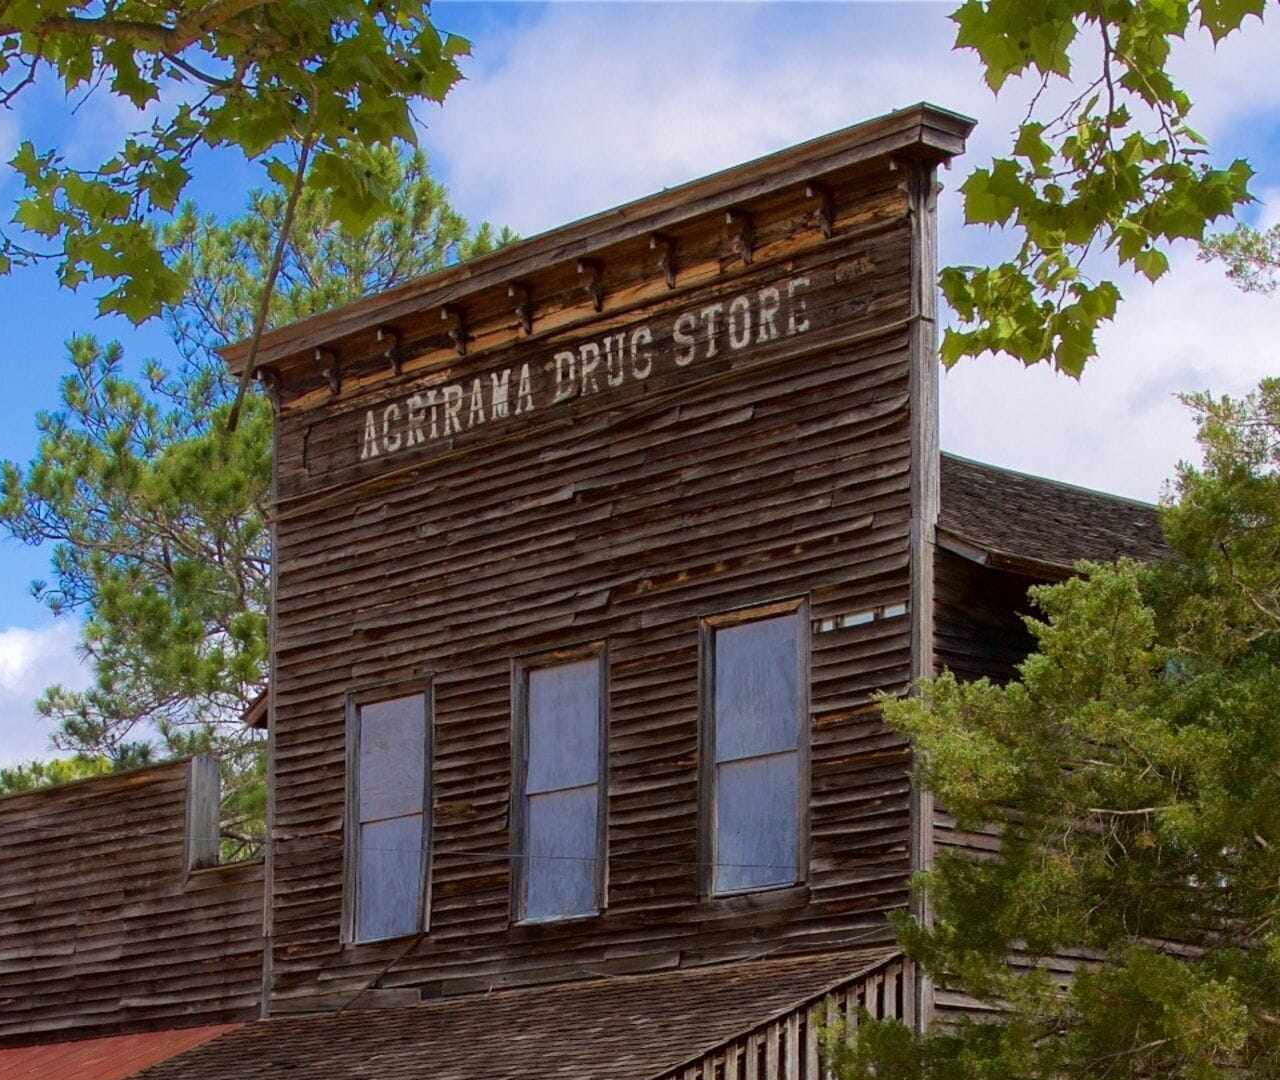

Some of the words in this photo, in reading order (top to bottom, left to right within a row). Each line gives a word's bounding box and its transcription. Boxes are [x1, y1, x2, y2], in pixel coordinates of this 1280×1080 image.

[360, 363, 535, 460] AGRIRAMA
[553, 325, 653, 402] DRUG
[672, 277, 811, 367] STORE
